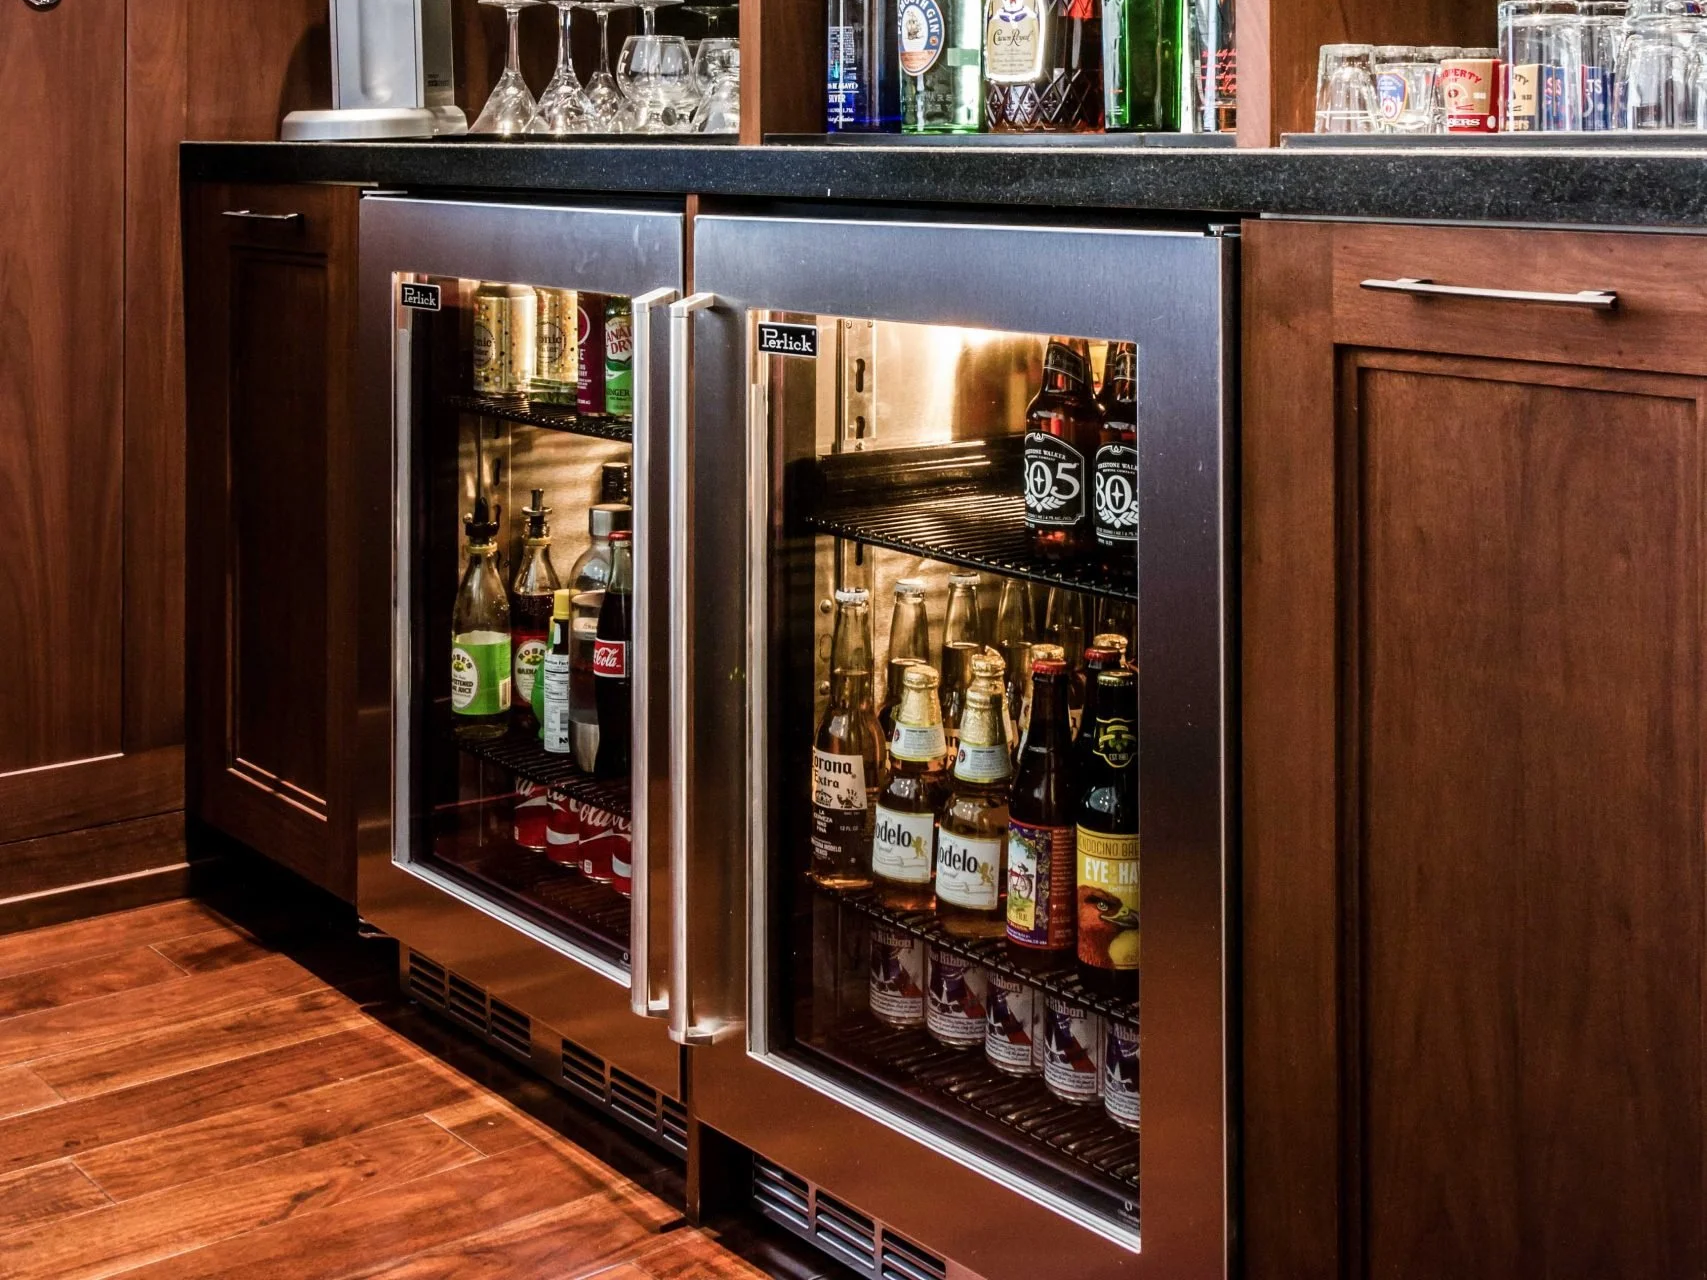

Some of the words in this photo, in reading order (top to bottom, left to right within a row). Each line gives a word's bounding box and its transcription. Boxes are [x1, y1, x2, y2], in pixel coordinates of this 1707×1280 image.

[926, 9, 940, 33] GIN
[993, 28, 1012, 47] Crown
[1010, 28, 1032, 47] Royal
[404, 287, 437, 306] Perlick
[762, 328, 813, 352] Perlick
[1043, 450, 1066, 461] WALKER
[814, 769, 839, 788] Extra
[1085, 859, 1109, 883] EYE
[1118, 861, 1138, 885] HA
